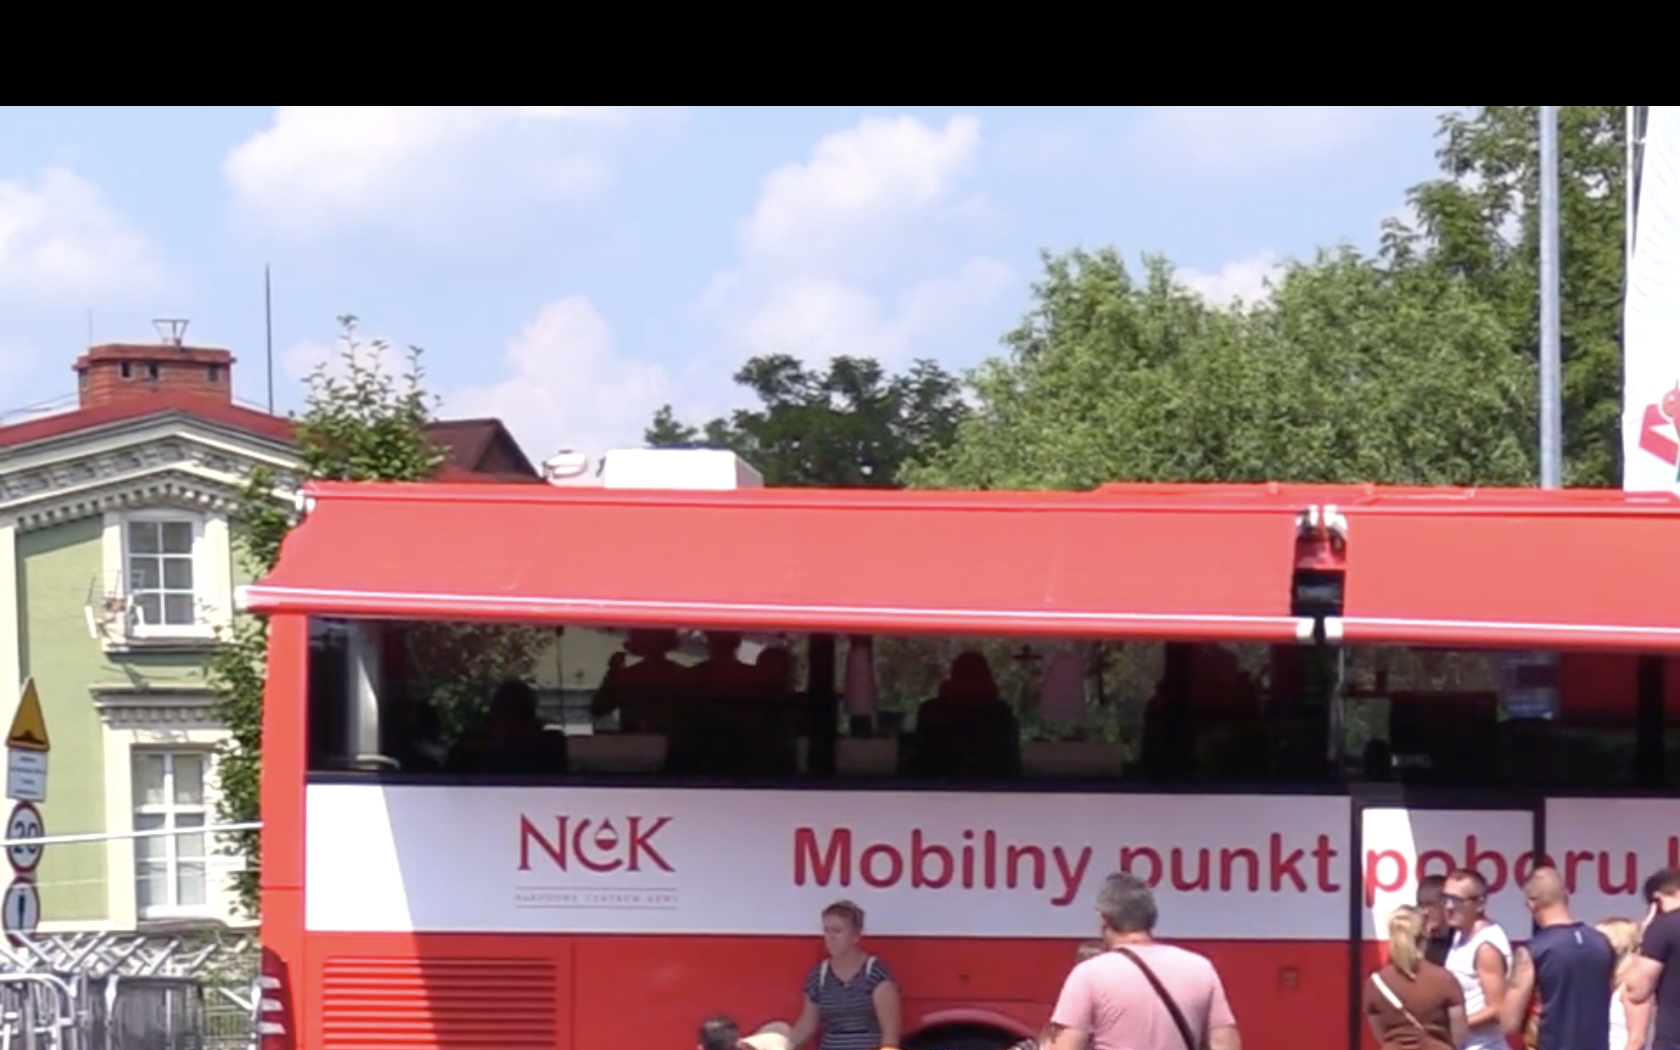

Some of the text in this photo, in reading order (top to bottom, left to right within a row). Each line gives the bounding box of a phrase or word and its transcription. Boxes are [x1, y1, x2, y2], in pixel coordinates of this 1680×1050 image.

[517, 813, 677, 873] NCK
[793, 827, 1093, 906] Mobilny
[1119, 832, 1341, 893] punkt
